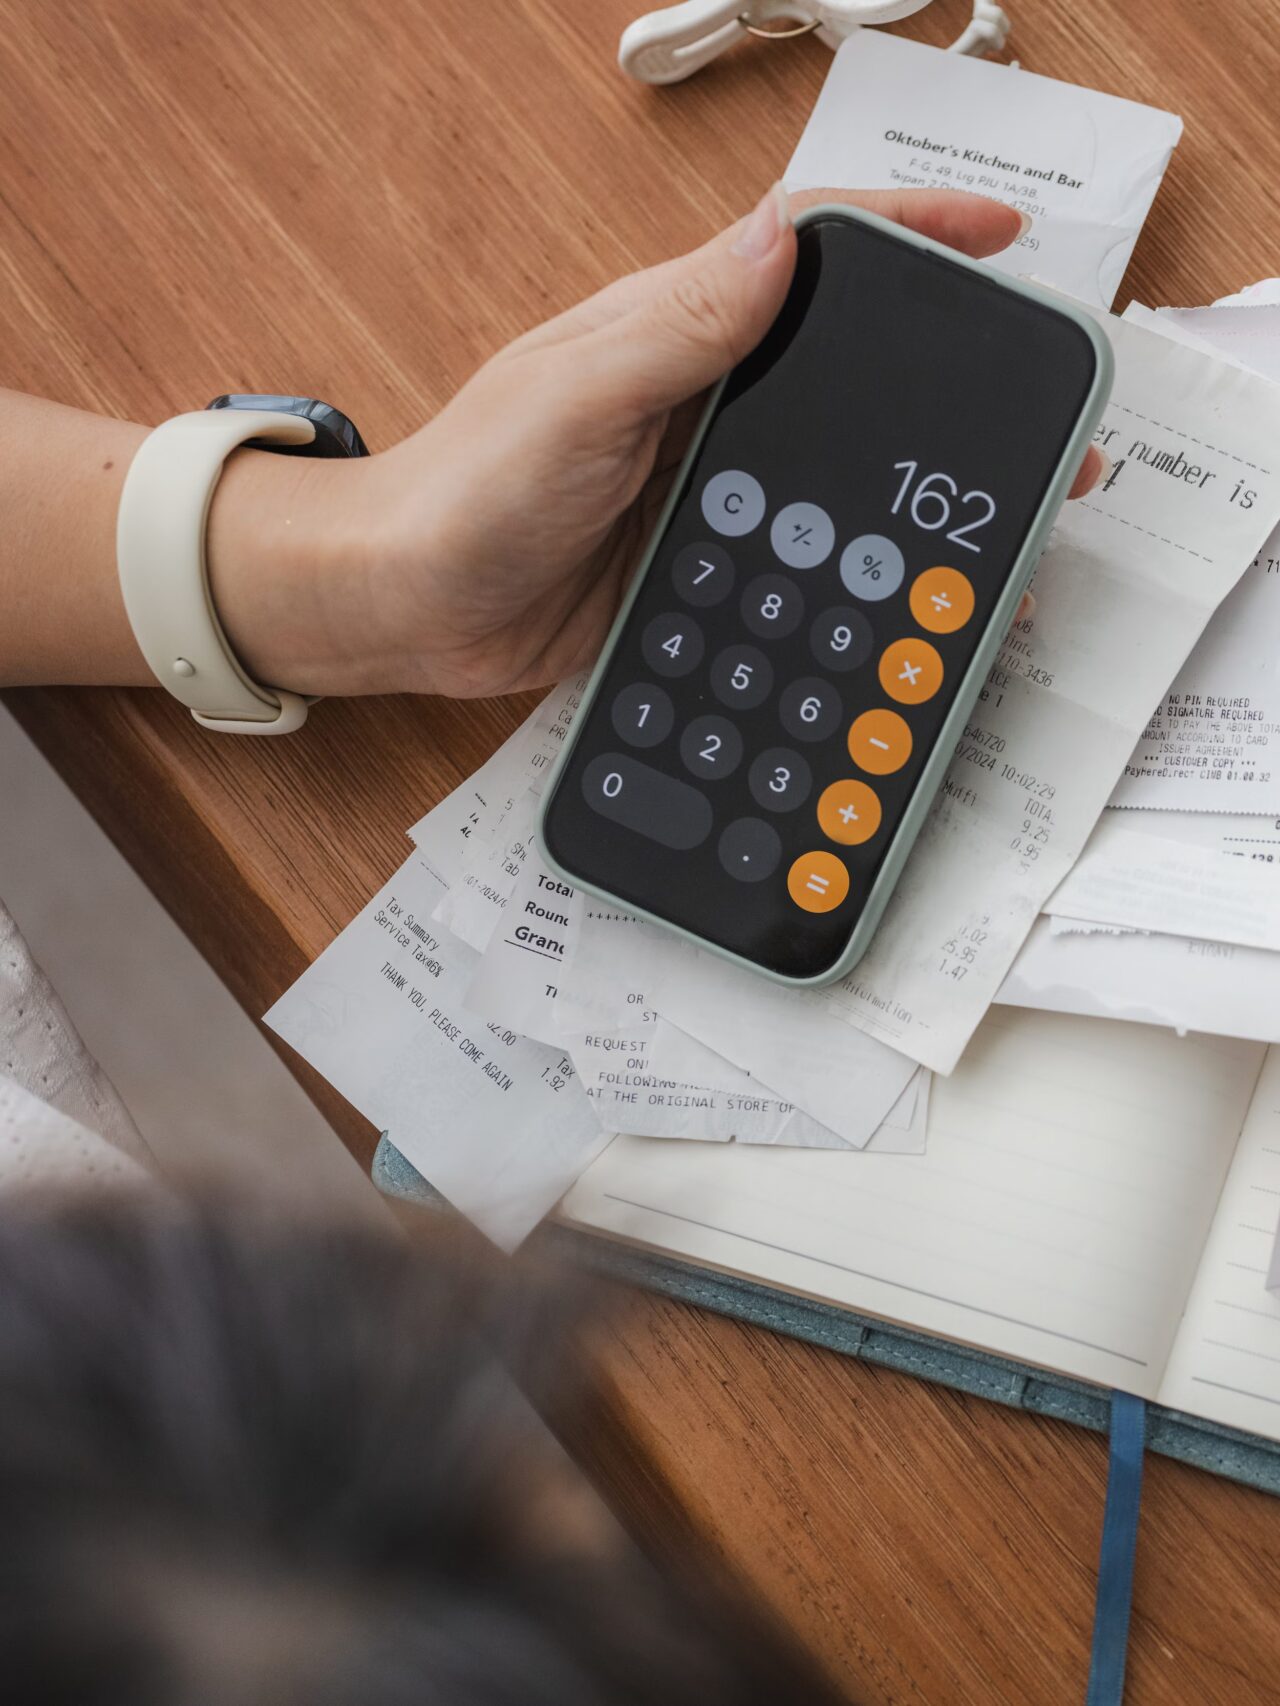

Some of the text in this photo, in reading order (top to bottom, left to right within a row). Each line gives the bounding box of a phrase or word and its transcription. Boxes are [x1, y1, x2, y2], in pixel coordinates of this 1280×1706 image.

[884, 129, 1084, 190] Oktober's Kitchen and Bar
[889, 169, 938, 189] Taipan 2
[956, 171, 974, 186] Lrg
[978, 175, 999, 189] PJU
[1092, 423, 1258, 510] er number is
[724, 492, 743, 514] C
[890, 460, 997, 553] 162
[692, 559, 852, 652] 7 8 9
[661, 633, 822, 723] 4 5 6
[988, 670, 1011, 690] ICE
[1167, 706, 1265, 722] SIGNATURE REQUIRED
[1185, 695, 1202, 706] PIN
[1206, 696, 1250, 709] REQUIRED
[1176, 731, 1225, 744] ACCORDING
[1231, 734, 1242, 744] TO
[1246, 734, 1268, 746] CARD
[1183, 719, 1200, 730] PAY
[1226, 722, 1254, 734] ABOVE
[636, 703, 790, 793] 1 2 3
[954, 743, 997, 772] 0/2024
[1159, 743, 1244, 757] ISSUER AGREEMENT
[1164, 756, 1235, 769] CUSTOMER COPY
[602, 771, 623, 798] 0
[1021, 819, 1049, 844] 9.25
[1010, 837, 1041, 861] 0.95
[384, 896, 441, 952] Tax Summary
[373, 909, 445, 979] Service Tax@6%
[937, 958, 969, 982] 1.47
[379, 961, 515, 1092] THANK YOU, PLEASE COME AGAIN
[584, 1035, 648, 1052] REQUEST
[540, 1066, 566, 1093] 1.92
[556, 1056, 577, 1079] Tax
[613, 1090, 638, 1105] THE
[648, 1094, 717, 1109] ORIGINAL
[727, 1099, 769, 1113] STORE
